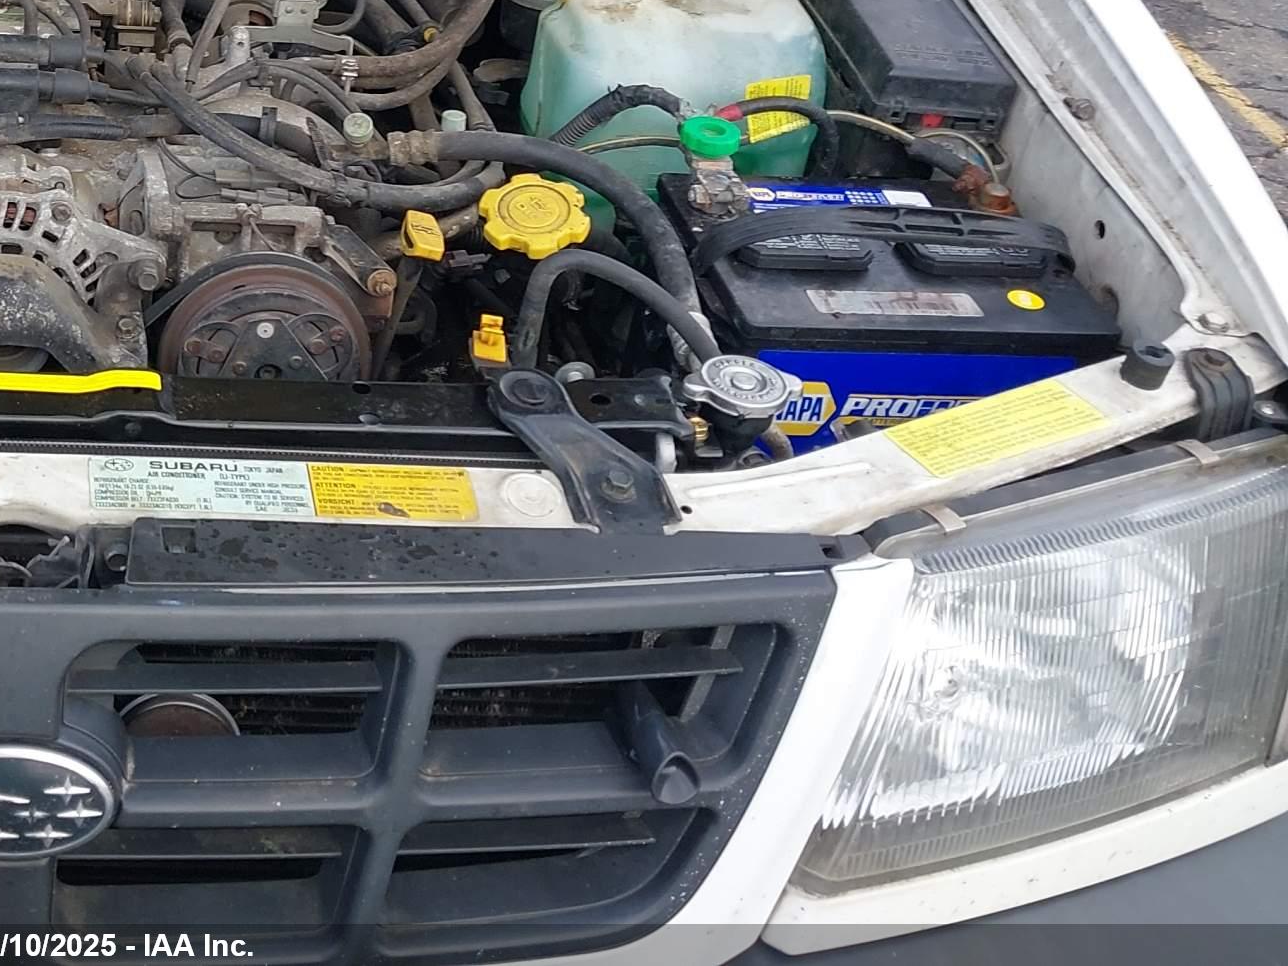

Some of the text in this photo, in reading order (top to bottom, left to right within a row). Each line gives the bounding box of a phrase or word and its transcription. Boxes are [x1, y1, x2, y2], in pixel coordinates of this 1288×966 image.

[149, 461, 237, 472] SUBARU
[311, 465, 344, 473] CAUTION
[161, 472, 206, 480] CONDITIONER
